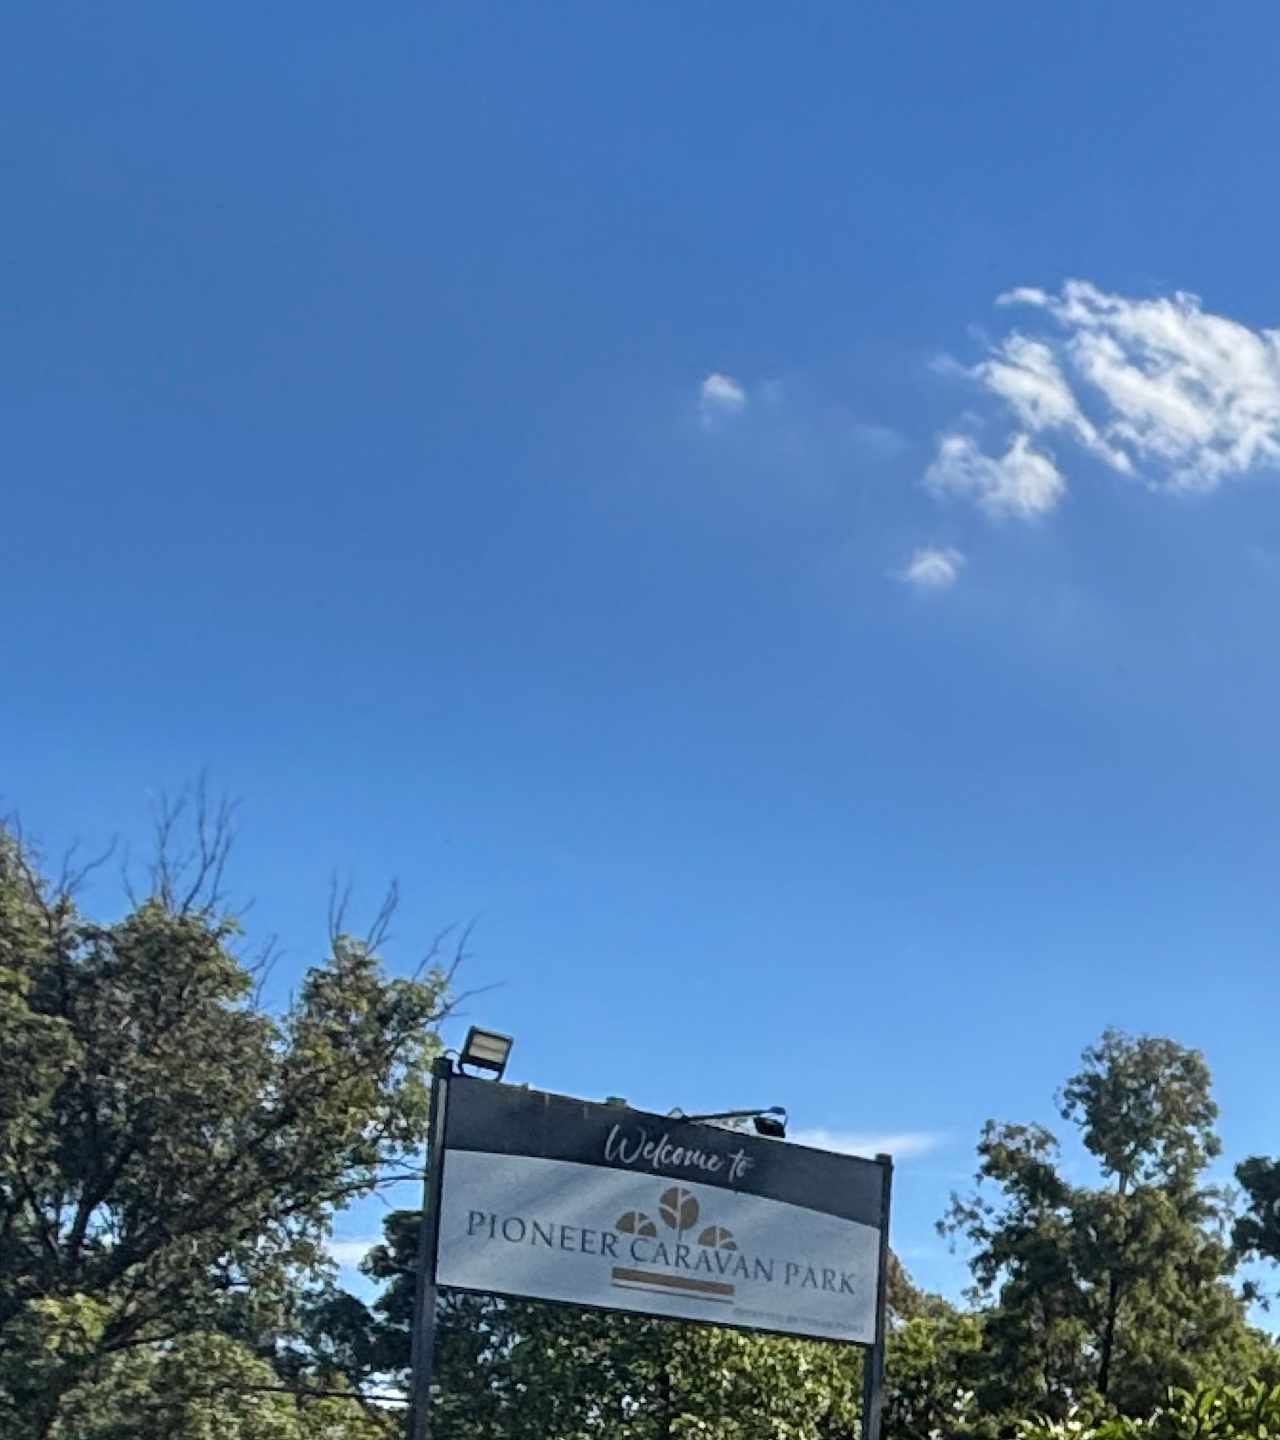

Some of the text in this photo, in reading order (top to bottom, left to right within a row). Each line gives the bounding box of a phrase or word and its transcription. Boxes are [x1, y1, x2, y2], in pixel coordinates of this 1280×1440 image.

[604, 1123, 755, 1183] Welcome to
[467, 1210, 856, 1295] PIONEER CARAVAN PARK
